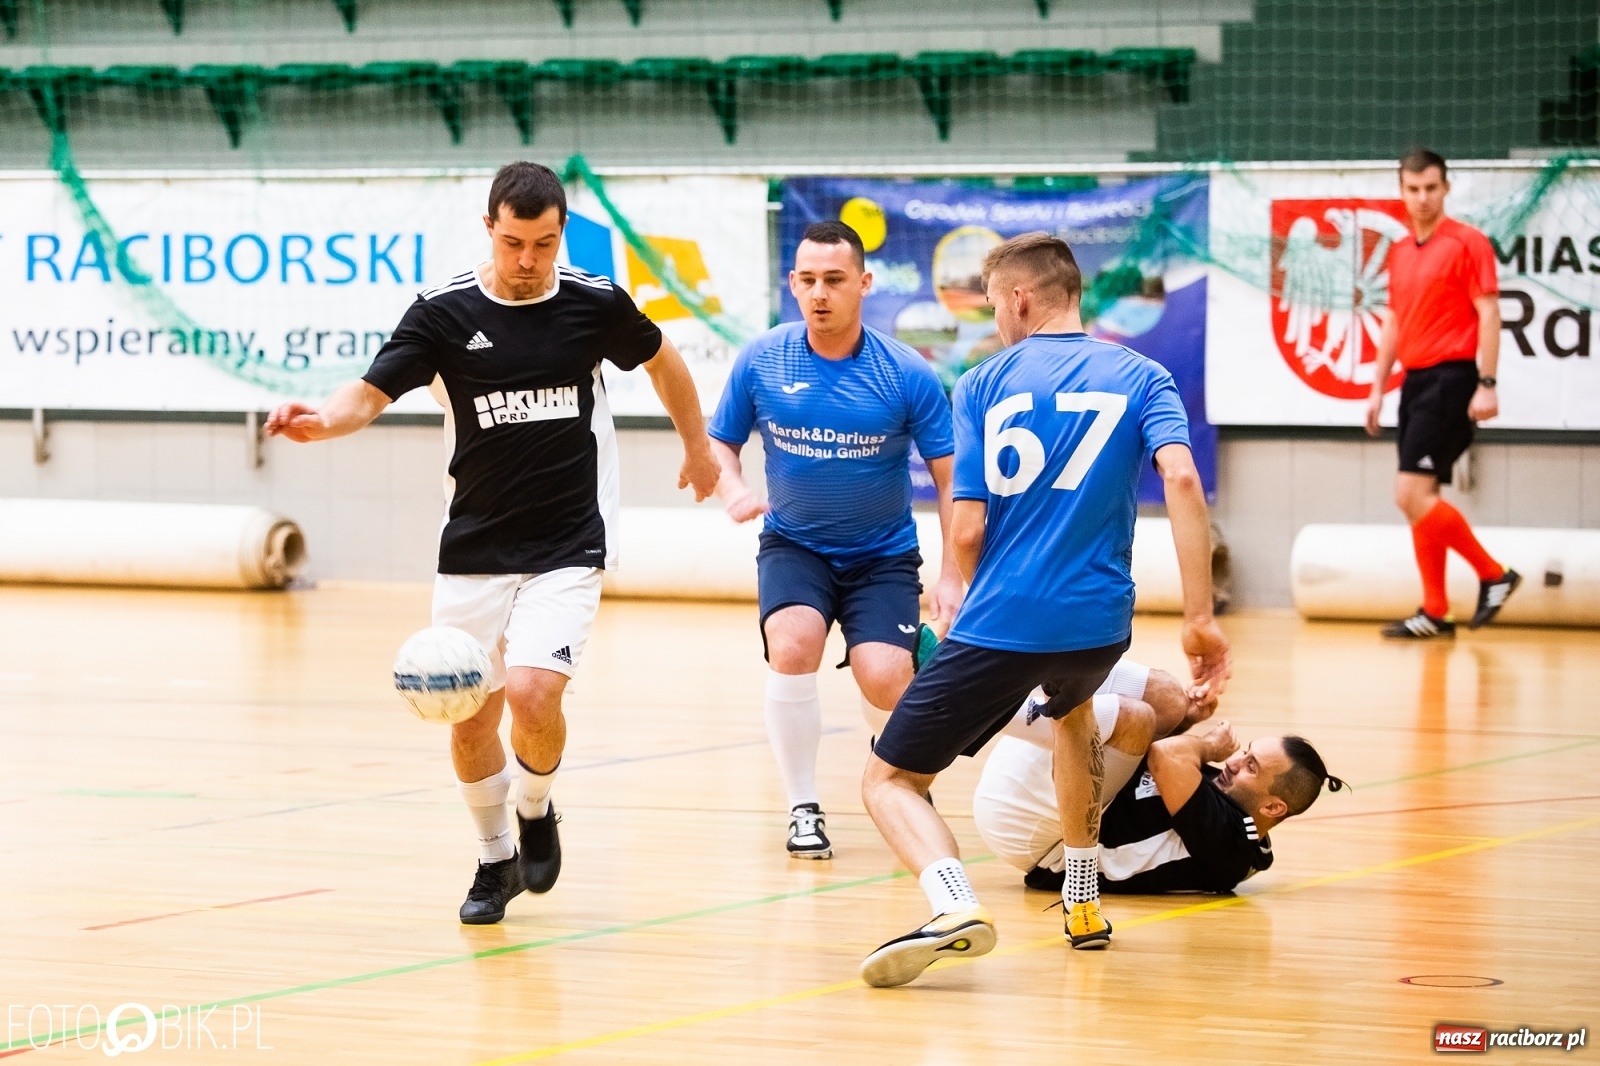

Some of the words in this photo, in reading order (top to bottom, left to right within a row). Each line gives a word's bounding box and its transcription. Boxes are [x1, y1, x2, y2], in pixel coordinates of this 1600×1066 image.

[26, 233, 425, 284] RACIBORSKI
[1492, 289, 1600, 358] Ra
[12, 318, 266, 365] wspieramy,
[466, 340, 494, 350] adidas
[504, 385, 579, 411] KUHN
[499, 412, 528, 422] PRD
[767, 421, 887, 445] Marek&Dariusz
[984, 391, 1128, 497] 67
[774, 437, 833, 459] Metallbau
[836, 446, 881, 459] GmbH
[551, 651, 573, 665] adidas
